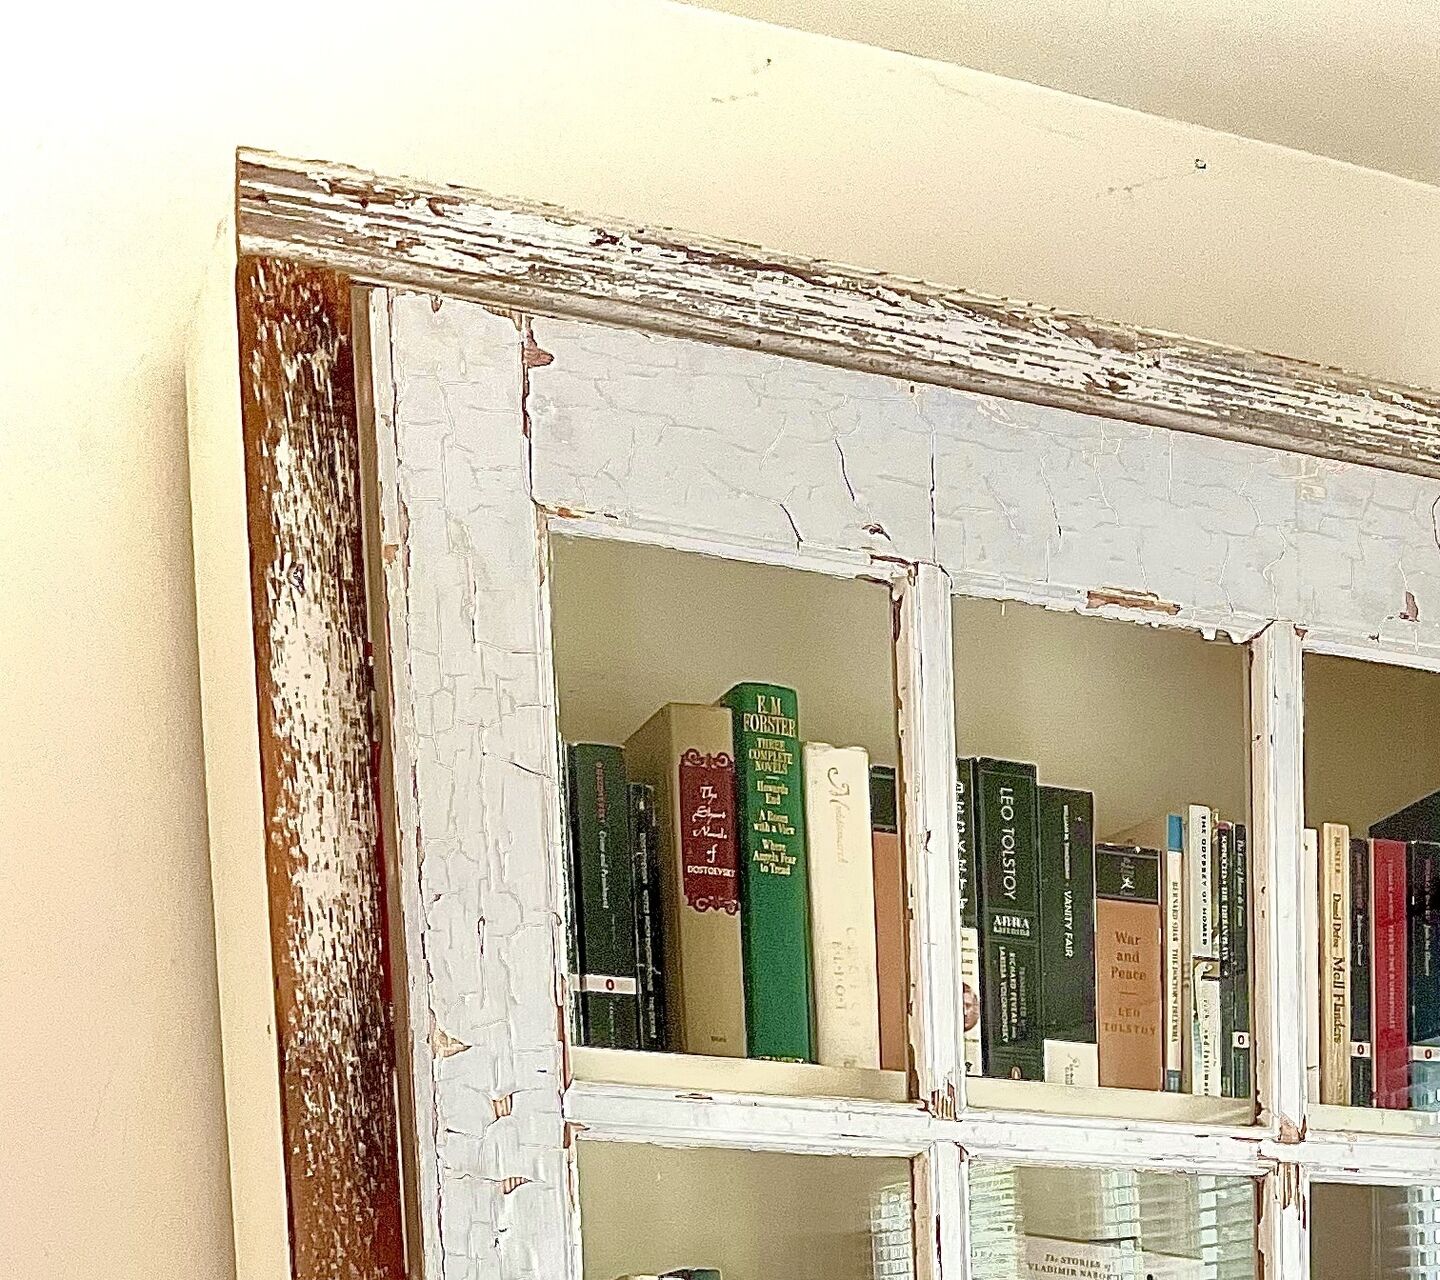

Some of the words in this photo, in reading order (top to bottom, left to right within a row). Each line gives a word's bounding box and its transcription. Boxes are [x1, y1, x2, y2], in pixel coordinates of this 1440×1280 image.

[743, 713, 797, 738] FORSTER
[749, 749, 793, 765] COMPLETE
[1000, 786, 1014, 822] LEO
[1200, 815, 1208, 836] THE
[1001, 827, 1016, 901] TOLSTOY
[1200, 838, 1208, 887] ODYSSEY
[1062, 890, 1074, 930] VANITY
[1114, 931, 1142, 947] War
[1201, 907, 1209, 946] HOMER
[1333, 923, 1342, 948] Defoe
[1063, 932, 1075, 958] FAIR
[1115, 950, 1140, 964] and
[1110, 966, 1147, 981] Peace
[1333, 956, 1345, 989] Moll
[1117, 1006, 1141, 1018] LEO
[1333, 993, 1346, 1045] Flanders
[1103, 1023, 1157, 1036] TOLSTOY
[1028, 1262, 1077, 1276] VLADIMIR
[1045, 1254, 1058, 1263] The
[1060, 1256, 1101, 1268] STORIES
